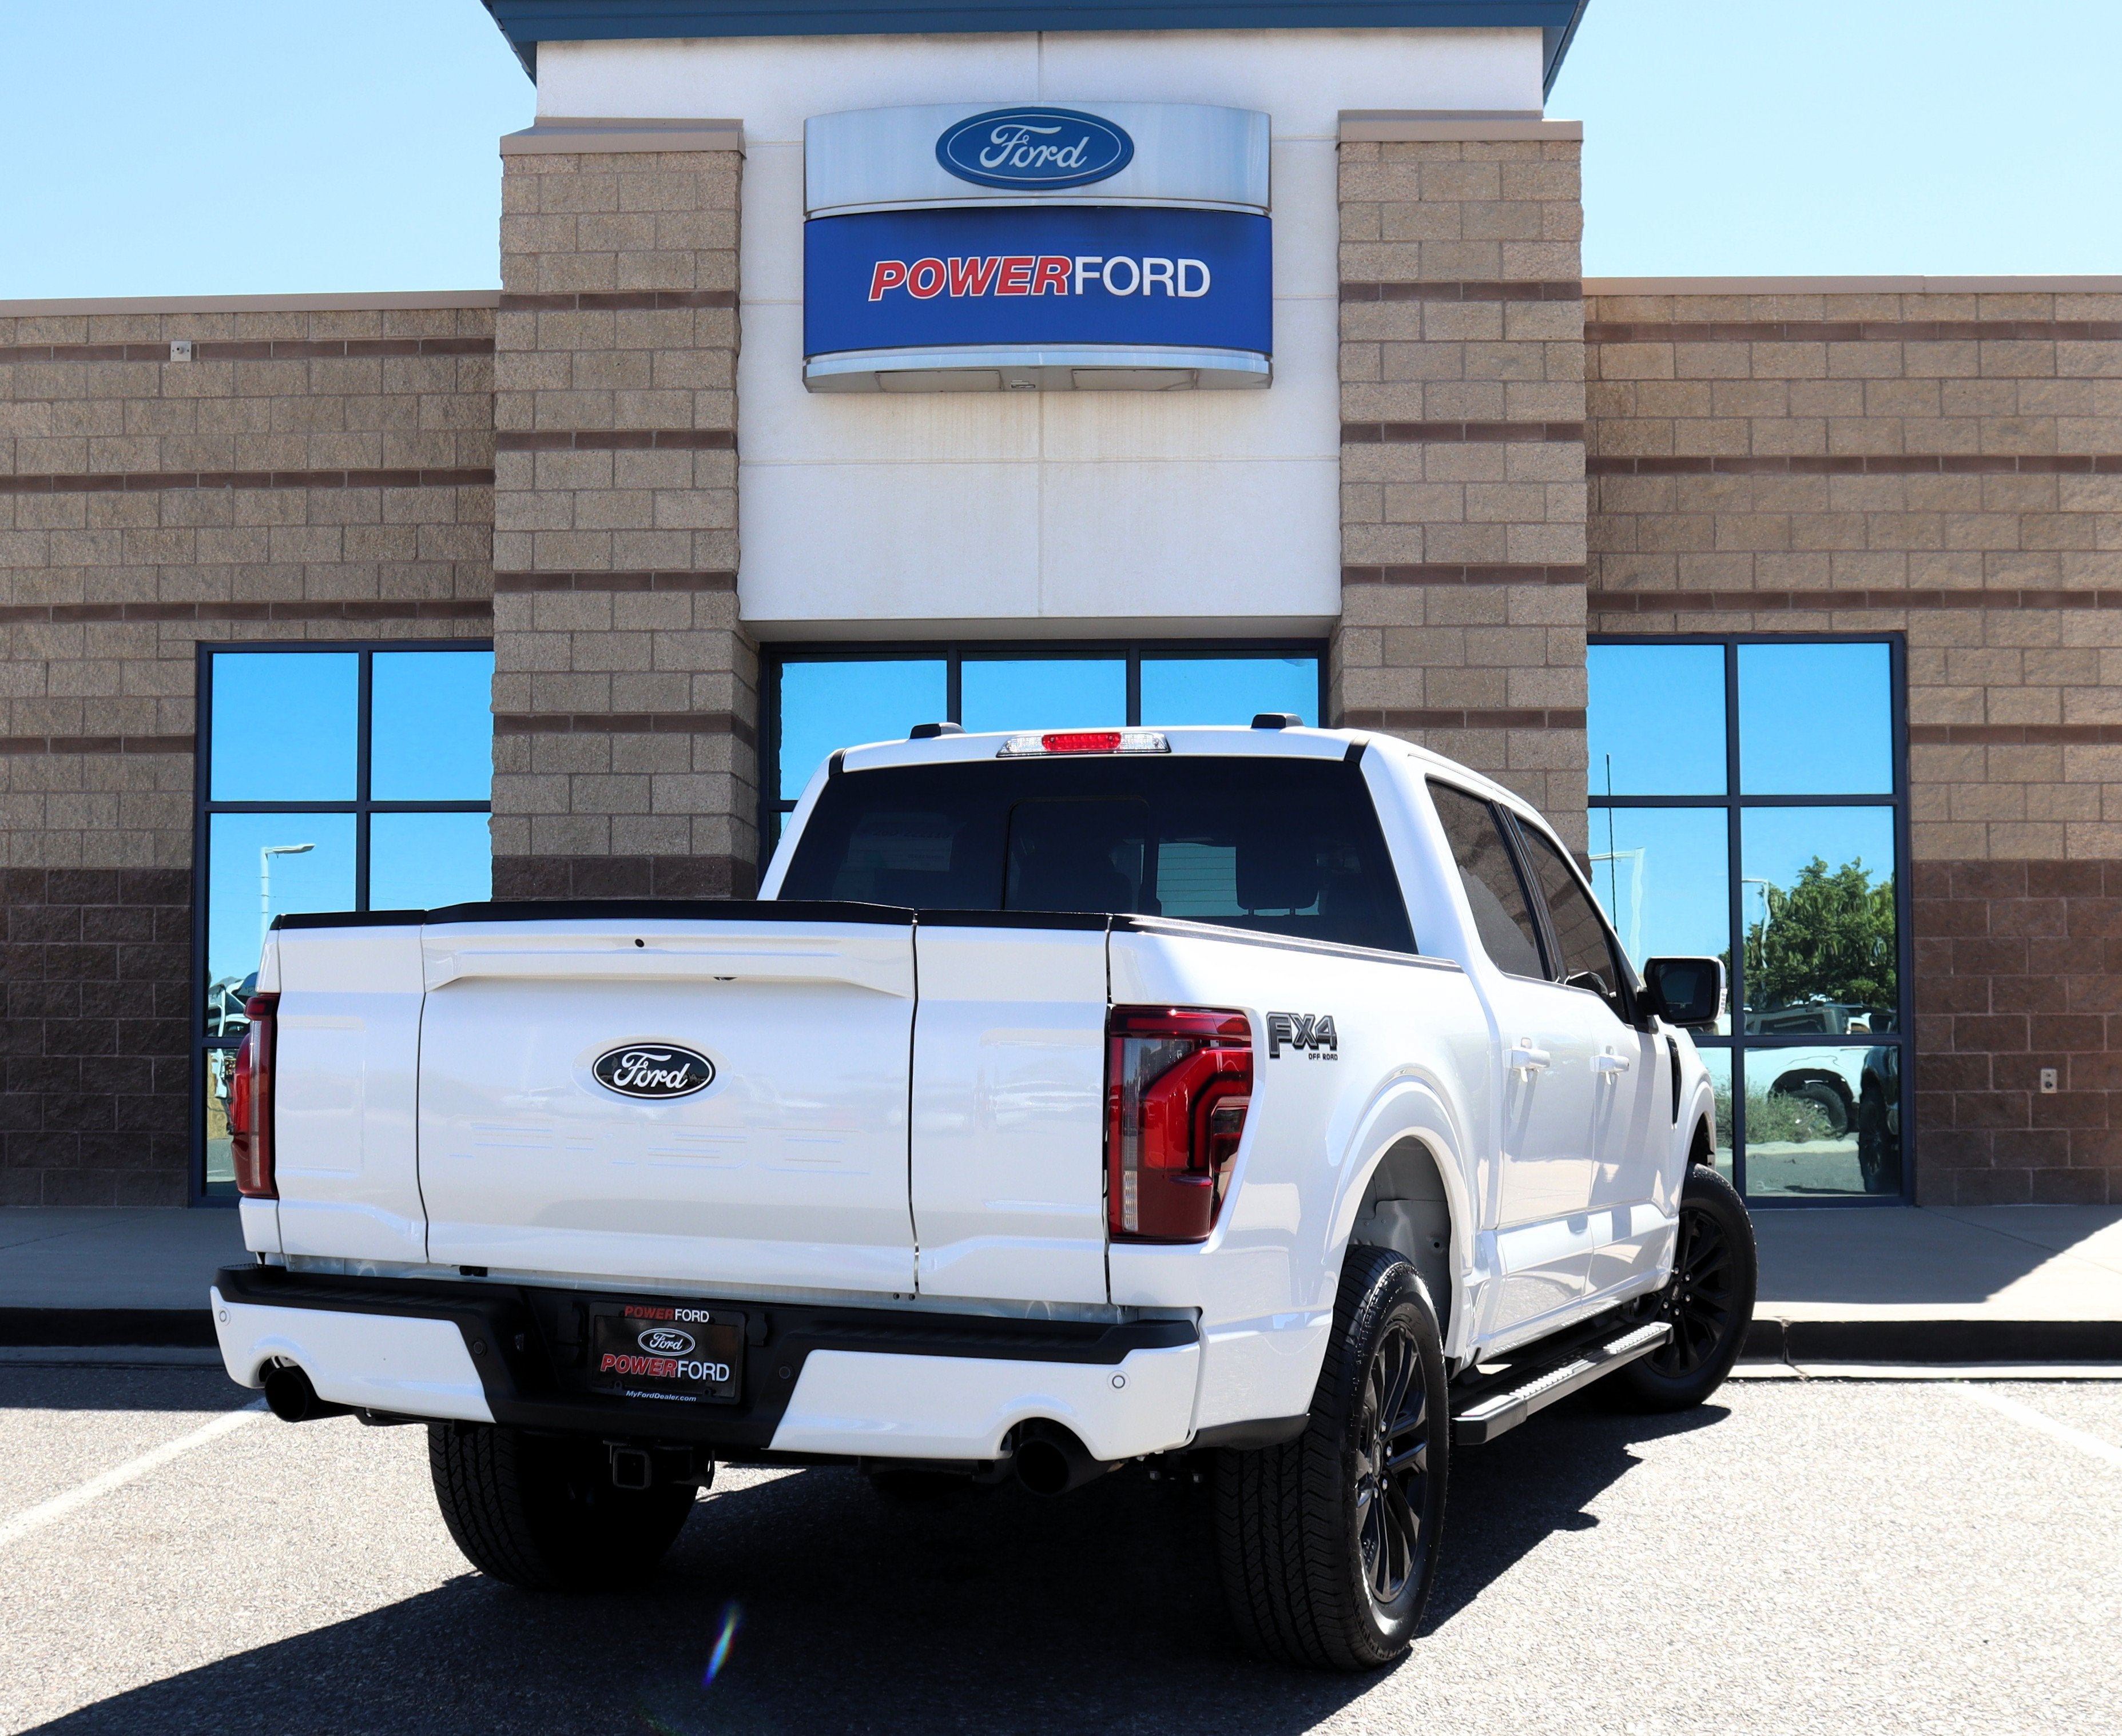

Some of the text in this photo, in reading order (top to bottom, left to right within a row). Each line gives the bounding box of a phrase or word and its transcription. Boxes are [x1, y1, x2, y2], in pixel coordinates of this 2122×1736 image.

[979, 124, 1088, 169] Ford
[868, 255, 1211, 302] POWERFORD
[1266, 1012, 1337, 1058] FX4
[613, 1052, 690, 1089] Ford
[650, 1332, 683, 1351] Ford
[626, 1390, 697, 1402] MyFordDealer.com
